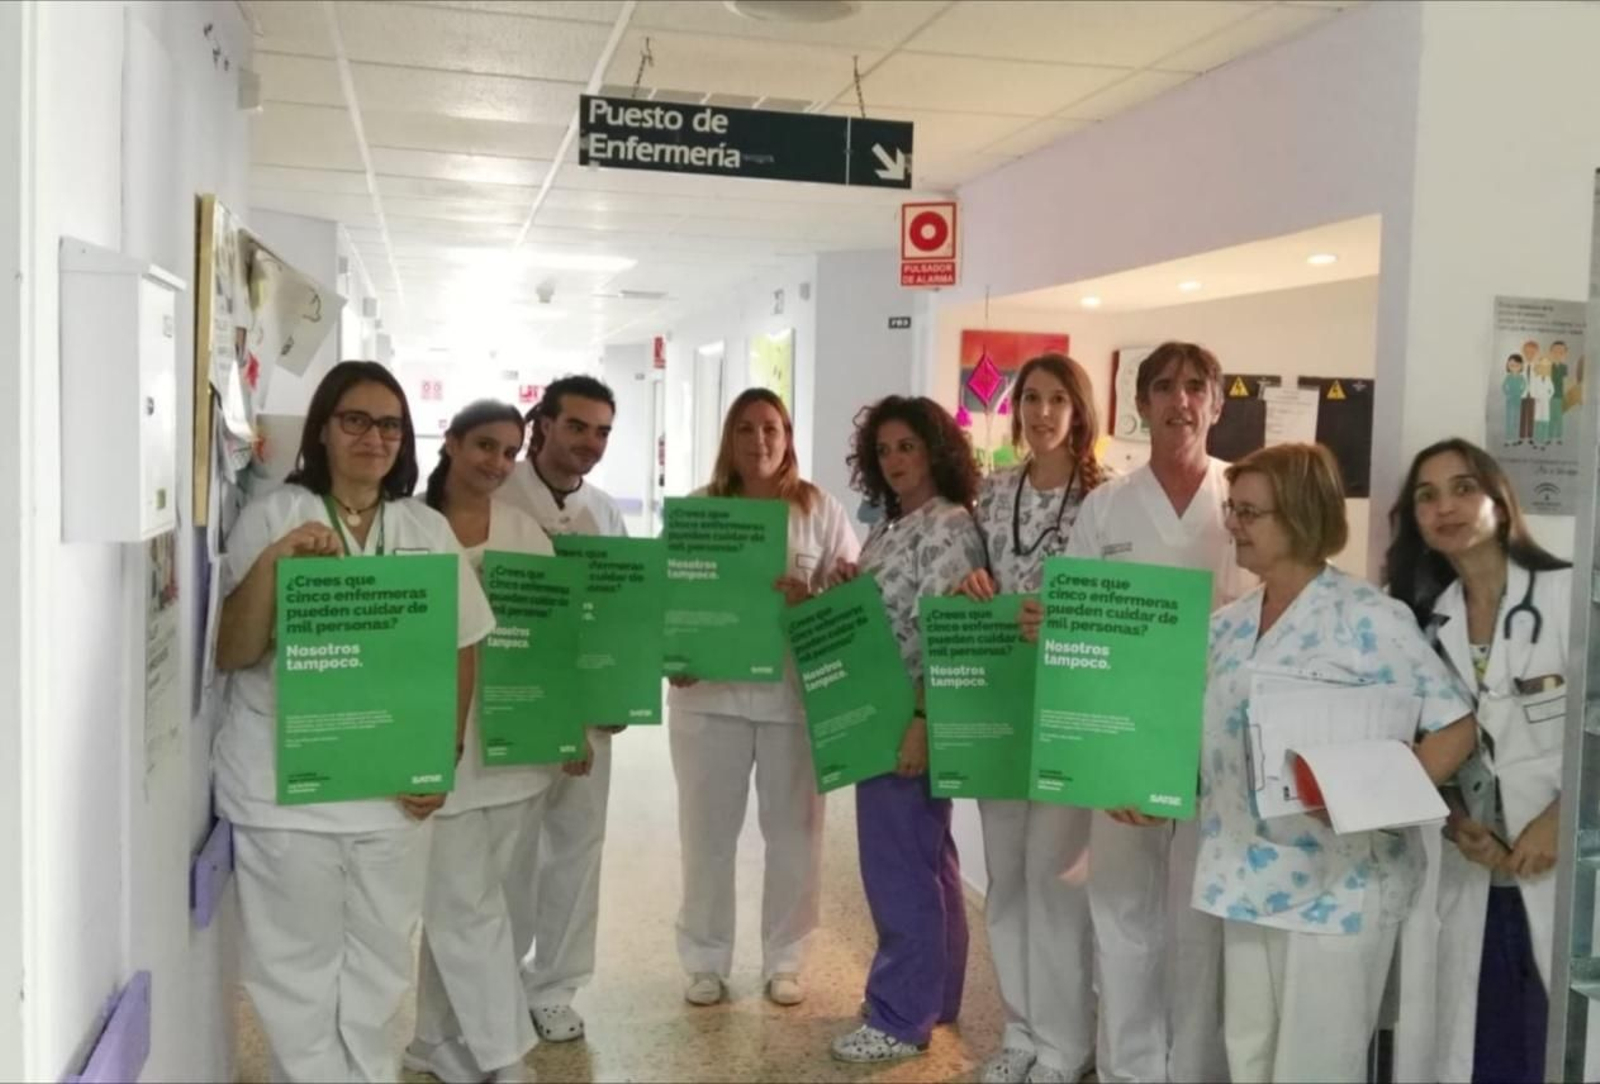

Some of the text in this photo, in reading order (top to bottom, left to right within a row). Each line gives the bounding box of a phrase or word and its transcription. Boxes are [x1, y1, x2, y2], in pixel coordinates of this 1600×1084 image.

[588, 99, 729, 133] Puesto de
[588, 133, 741, 168] Enfermería
[903, 264, 953, 273] PULSADOR
[916, 274, 954, 283] ALARMA
[667, 558, 718, 569] Nosotros
[286, 574, 376, 592] ¿Crees que
[667, 569, 720, 581] tampoco.
[1049, 573, 1131, 592] ¿Crees que
[286, 587, 427, 604] cinco enfermeras
[1047, 588, 1179, 611] cinco enfermeras
[286, 601, 428, 621] pueden cuidar de
[968, 610, 993, 621] que
[1046, 603, 1179, 625] pueden cuidar de
[286, 617, 399, 636] mil personas?
[927, 623, 960, 632] cinco
[1046, 617, 1149, 637] mil personas?
[927, 634, 975, 646] pueden
[1045, 638, 1110, 657] Nosotros
[286, 643, 361, 658] Nosotros
[929, 645, 1014, 659] mil personas?
[286, 657, 363, 672] tampoco.
[802, 659, 843, 681] Nosotros
[929, 664, 986, 676] Nosotros
[1044, 653, 1112, 670] tampoco.
[805, 669, 849, 692] tampoco.
[930, 676, 989, 689] tampoco.
